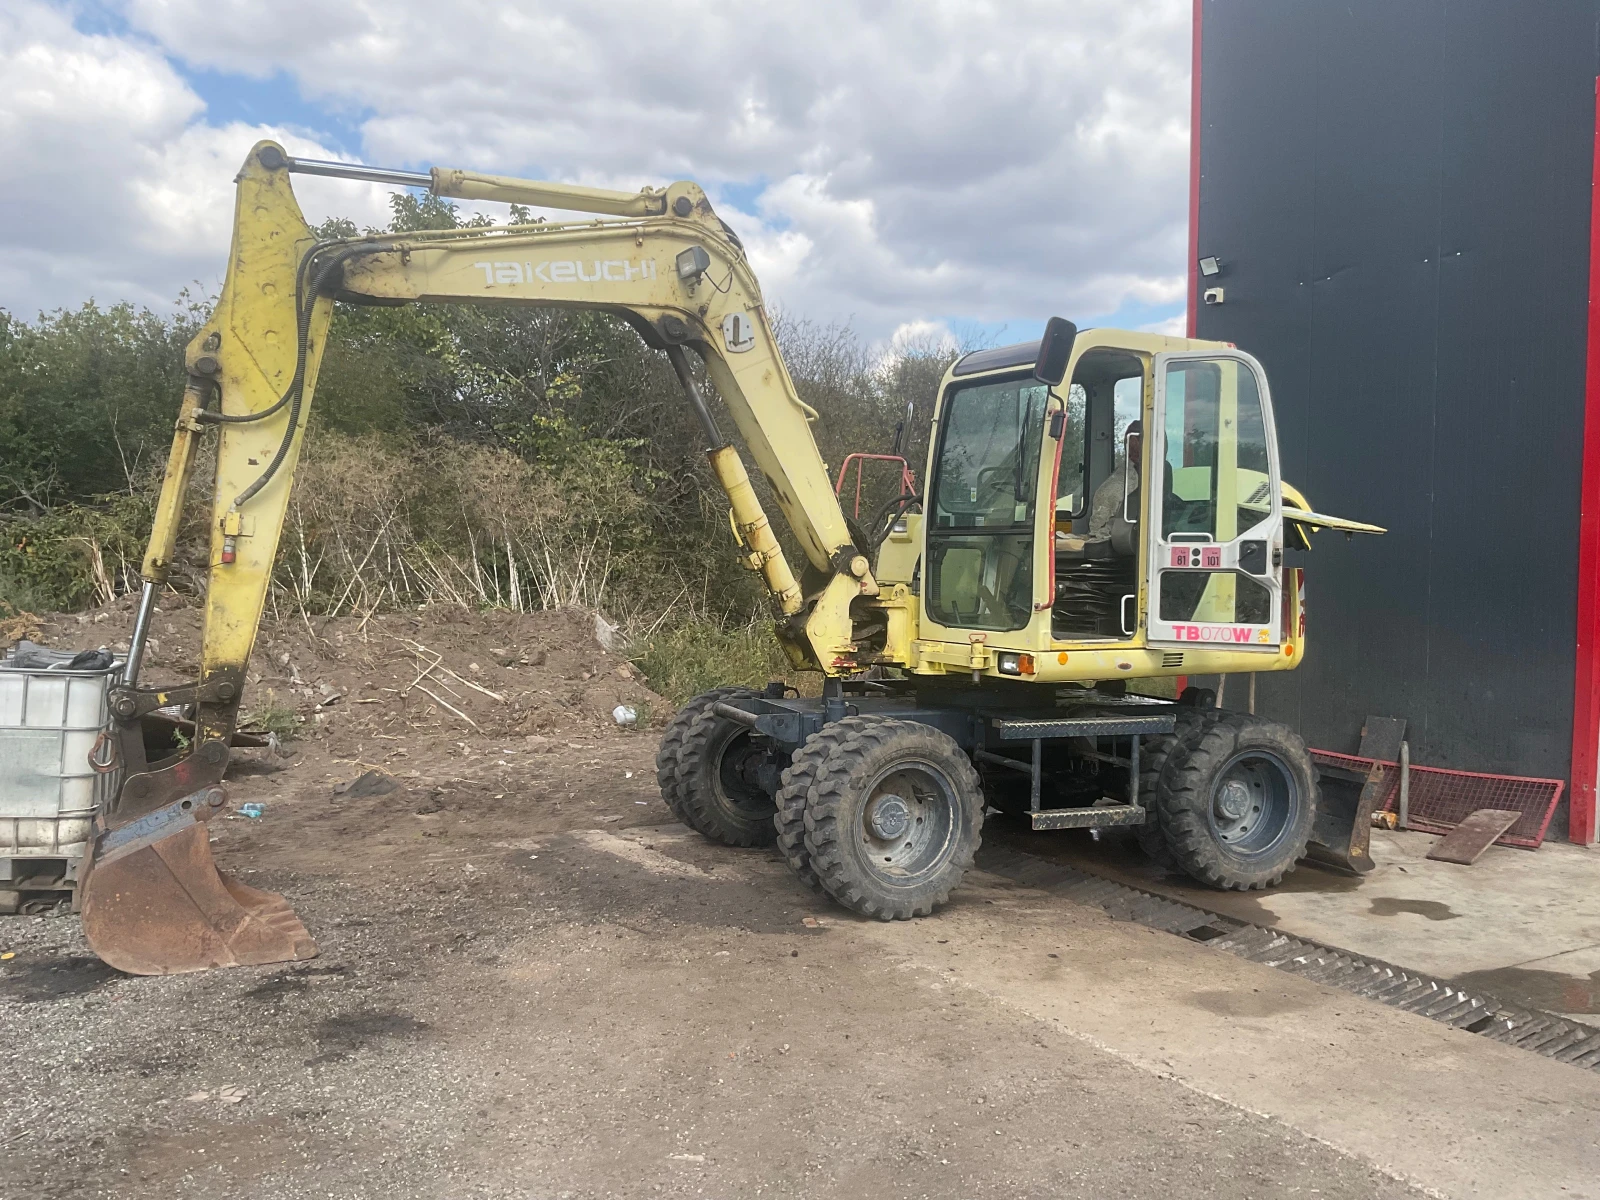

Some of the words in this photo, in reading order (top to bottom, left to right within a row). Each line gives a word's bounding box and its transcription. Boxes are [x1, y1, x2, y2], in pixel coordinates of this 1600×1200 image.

[1177, 555, 1186, 565] 81
[1207, 556, 1219, 566] 101
[1172, 625, 1253, 642] TB070W
